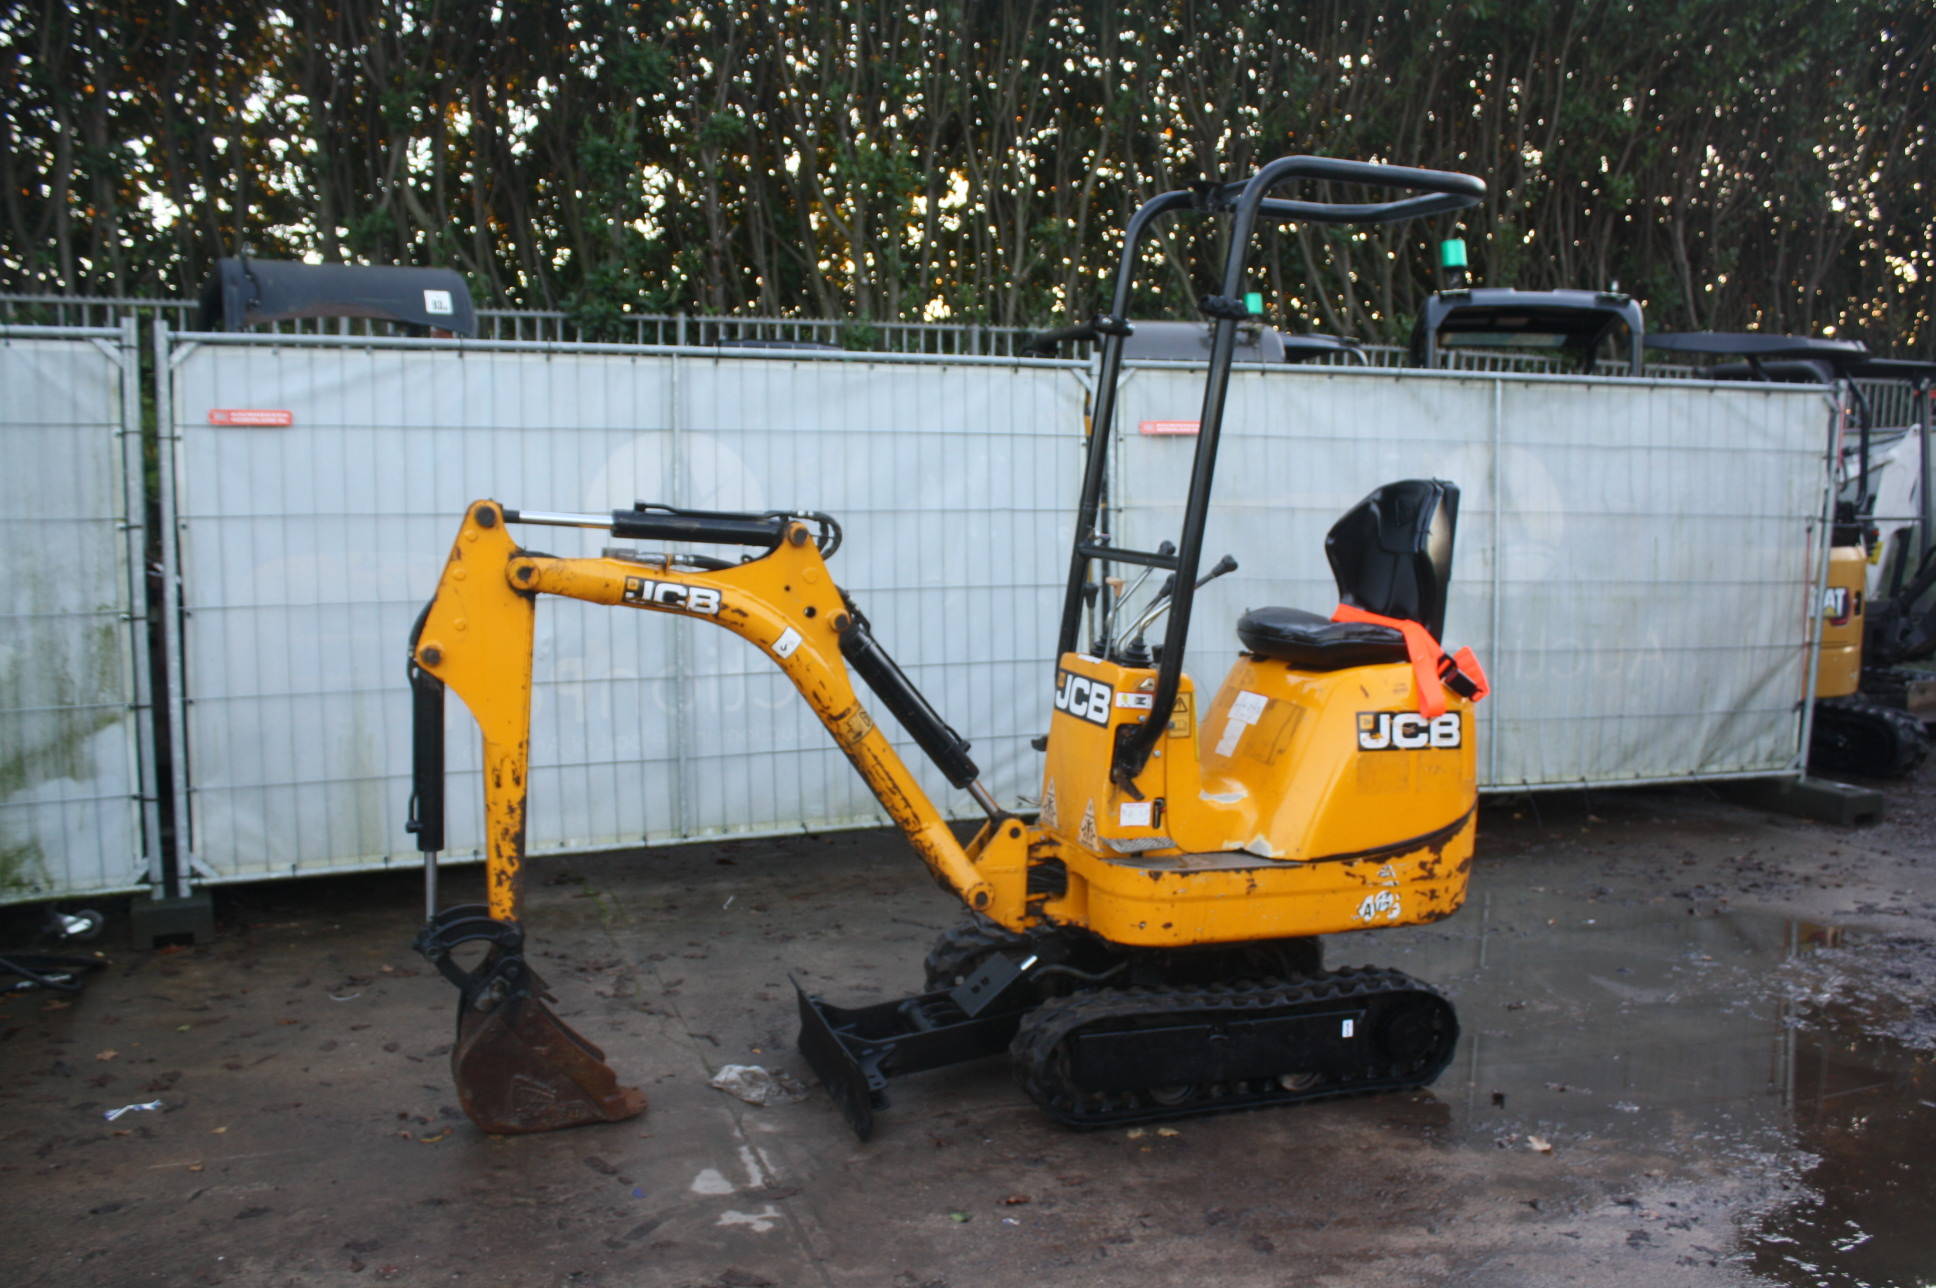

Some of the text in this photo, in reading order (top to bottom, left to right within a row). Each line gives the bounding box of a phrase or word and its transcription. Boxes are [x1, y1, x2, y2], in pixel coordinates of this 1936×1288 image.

[624, 579, 722, 615] JCB
[1055, 673, 1112, 725] JCB
[1359, 712, 1461, 750] JCB
